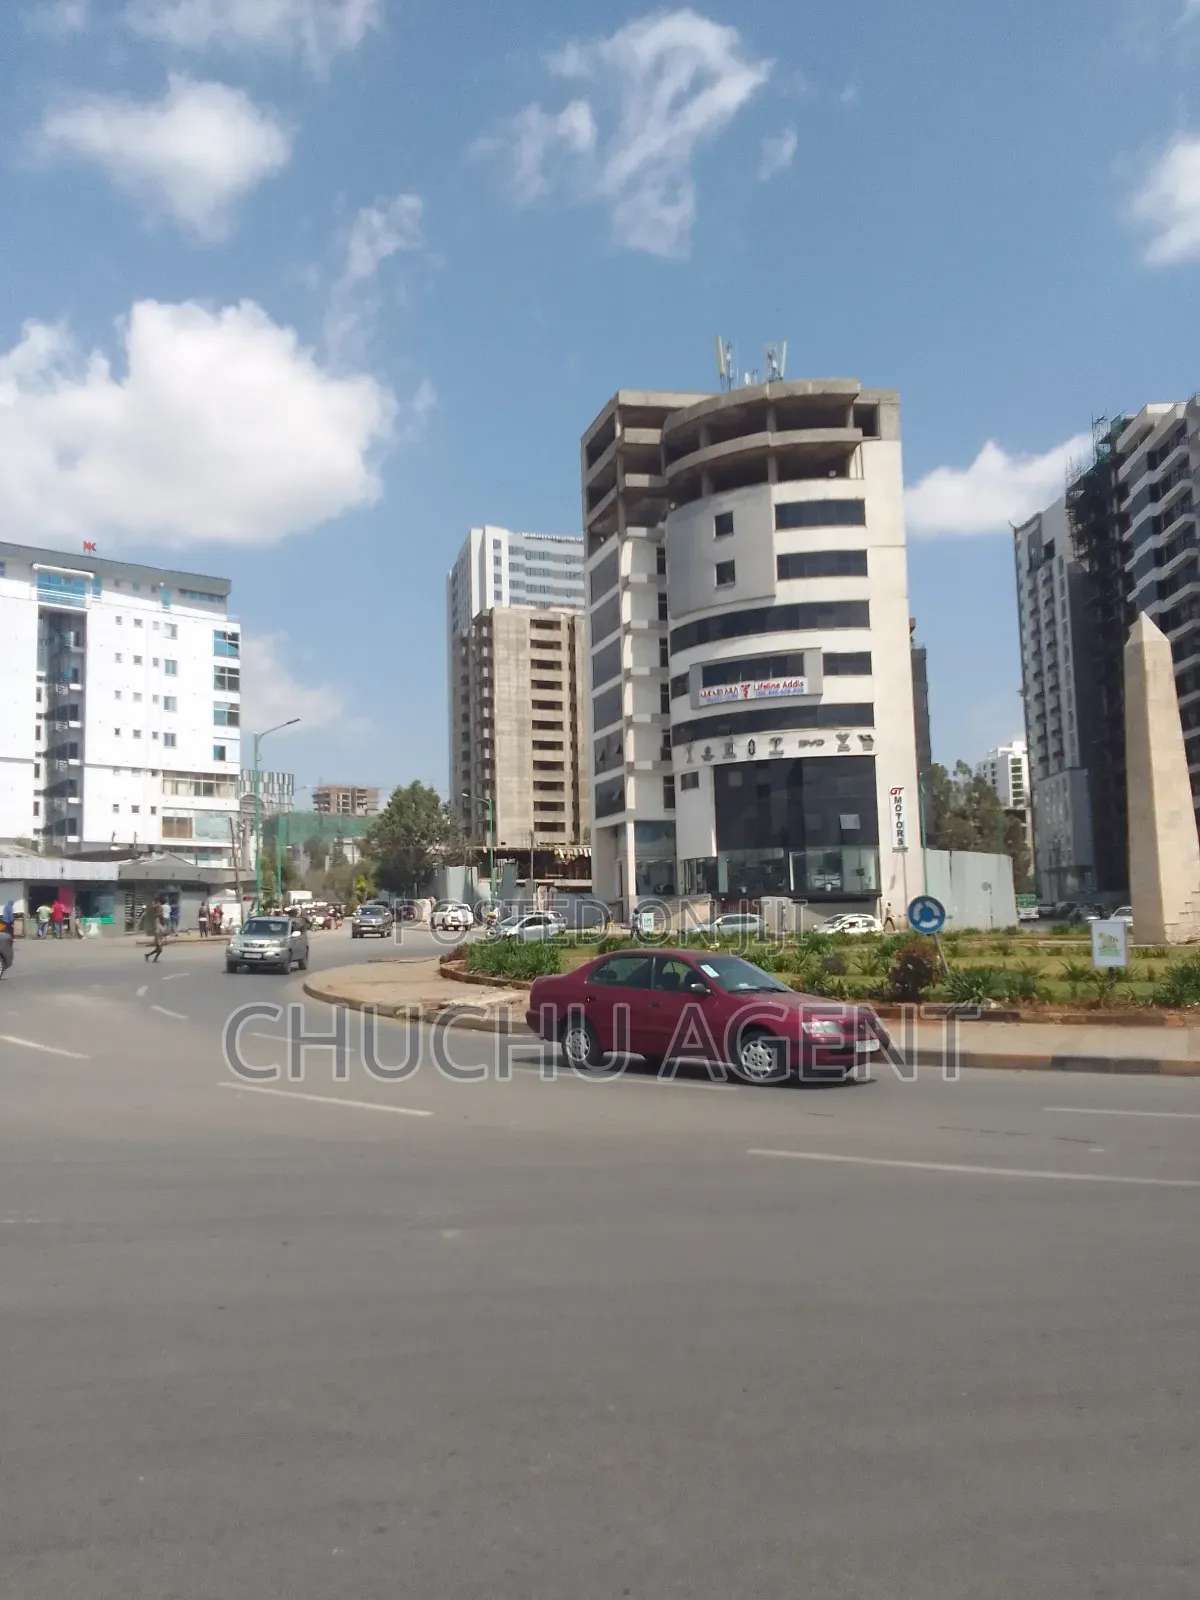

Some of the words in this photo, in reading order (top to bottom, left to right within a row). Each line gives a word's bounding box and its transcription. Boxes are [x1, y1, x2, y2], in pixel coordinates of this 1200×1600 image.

[753, 683, 780, 691] Lifeline
[782, 679, 804, 688] Addis
[890, 787, 905, 795] GT
[894, 796, 904, 845] MOTORS
